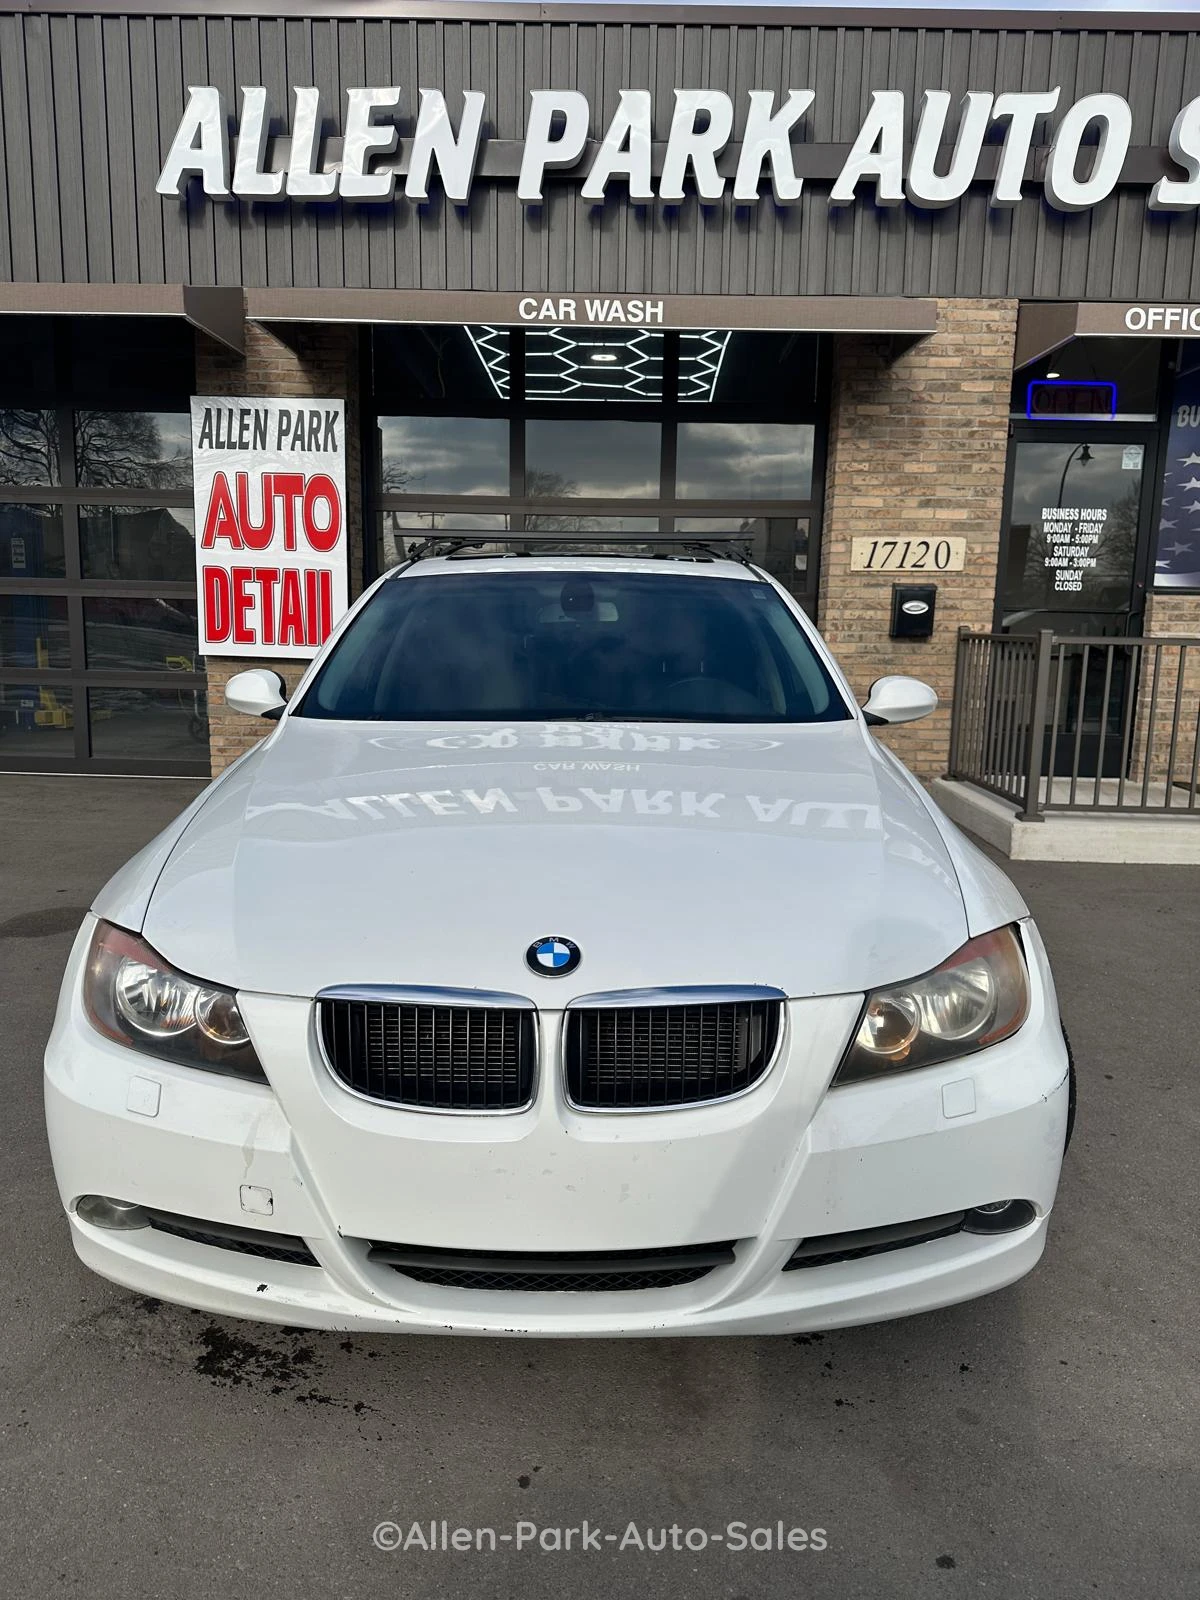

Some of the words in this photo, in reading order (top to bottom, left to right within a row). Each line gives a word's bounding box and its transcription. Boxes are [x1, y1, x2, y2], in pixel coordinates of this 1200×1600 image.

[156, 86, 485, 203] ALLEN
[517, 88, 815, 203] PARK
[829, 86, 1132, 209] AUTO
[518, 298, 576, 320] CAR
[584, 299, 664, 323] WASH
[198, 407, 268, 451] ALLEN
[276, 408, 339, 452] PARK
[201, 471, 341, 552] AUTO
[1042, 508, 1079, 520] BUSINESS
[1080, 508, 1107, 521] HOURS
[1043, 522, 1072, 533] MONDAY
[1079, 523, 1104, 533] FRIDAY
[1046, 534, 1071, 543] 9:00AM
[1075, 534, 1099, 544] 5:00PM
[863, 540, 951, 569] 17120
[1053, 546, 1089, 557] SATURDAY
[1044, 557, 1069, 567] 9:00AM
[1073, 558, 1097, 567] 3:00PM
[1055, 570, 1083, 580] SUNDAY
[1054, 581, 1082, 591] CLOSED
